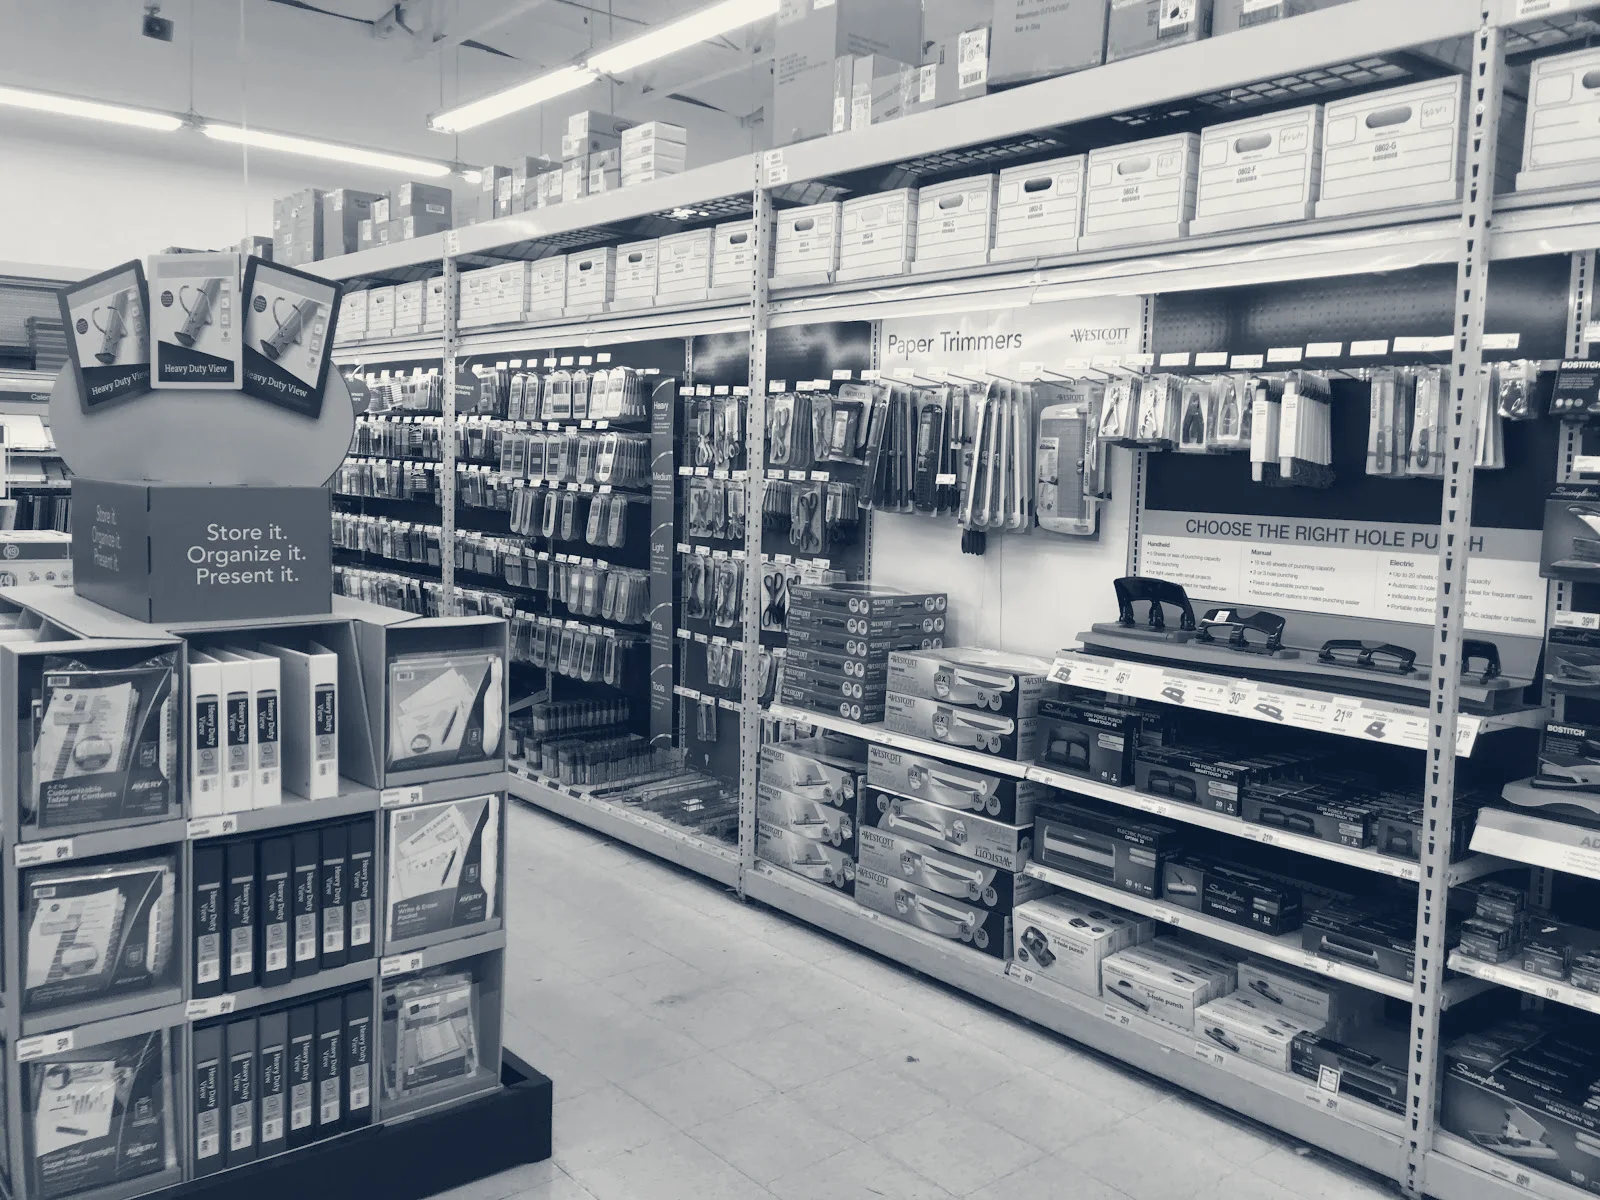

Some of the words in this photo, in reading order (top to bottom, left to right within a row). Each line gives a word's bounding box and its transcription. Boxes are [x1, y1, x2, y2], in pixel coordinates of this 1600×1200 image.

[1072, 327, 1130, 342] WESTCOTT
[888, 334, 934, 360] Paper
[940, 330, 1022, 352] Trimmers
[165, 364, 188, 374] Heavy
[189, 364, 206, 374] Duty
[207, 364, 227, 373] View
[92, 379, 114, 396] Heavy
[114, 375, 132, 389] Duty
[131, 370, 149, 383] View
[243, 369, 267, 385] Heavy
[267, 376, 287, 391] Duty
[288, 383, 308, 397] View
[654, 401, 668, 411] Heavy
[653, 472, 672, 481] Medium
[1550, 486, 1599, 499] Swingline
[96, 504, 110, 524] Store
[92, 526, 115, 548] Organize
[207, 523, 262, 541] Store
[269, 523, 288, 540] it.
[1186, 519, 1252, 537] CHOOSE
[1257, 523, 1290, 539] THE
[1295, 526, 1349, 543] RIGHT
[1355, 529, 1405, 547] HOLE
[1411, 532, 1483, 552] PUH
[187, 545, 281, 567] Organize
[288, 544, 307, 561] it.
[652, 543, 664, 553] Light
[94, 548, 112, 570] Present
[196, 568, 274, 585] Present
[280, 566, 299, 582] it.
[652, 621, 663, 630] Kids
[891, 655, 917, 667] WESTCOTT
[652, 682, 664, 692] Tools
[888, 694, 915, 706] WESTCOTT
[992, 695, 999, 703] 30
[207, 705, 215, 728] Heavy
[1108, 716, 1122, 724] PUNCH
[207, 729, 215, 746] Duty
[237, 725, 245, 742] Duty
[267, 723, 275, 740] Duty
[1547, 724, 1586, 736] BOSTITCH
[991, 737, 998, 746] 30
[762, 746, 784, 758] WESTCOTT
[871, 747, 902, 763] WESTCOTT
[1216, 767, 1234, 775] PUNCH
[132, 781, 162, 790] AVERY
[759, 785, 782, 797] WESTCOTT
[989, 798, 998, 808] 30
[760, 824, 783, 836] WESTCOTT
[862, 831, 894, 847] WESTCOTT
[975, 849, 1012, 867] WESTCOTT
[858, 869, 889, 885] WESTCOTT
[209, 890, 217, 913] Heavy
[333, 888, 341, 904] Duty
[986, 890, 994, 898] 30
[305, 895, 313, 911] Duty
[398, 905, 415, 914] Write
[241, 907, 250, 924] Duty
[276, 904, 284, 921] Duty
[208, 914, 217, 932] Duty
[977, 932, 985, 940] 30
[1053, 939, 1068, 948] 3-hole
[1069, 946, 1084, 955] punch
[1147, 993, 1164, 1004] 3-hole
[1165, 998, 1184, 1010] punch
[1451, 1062, 1506, 1091] Swingline
[1546, 1104, 1565, 1116] HEAVY
[1566, 1111, 1582, 1122] DUTY
